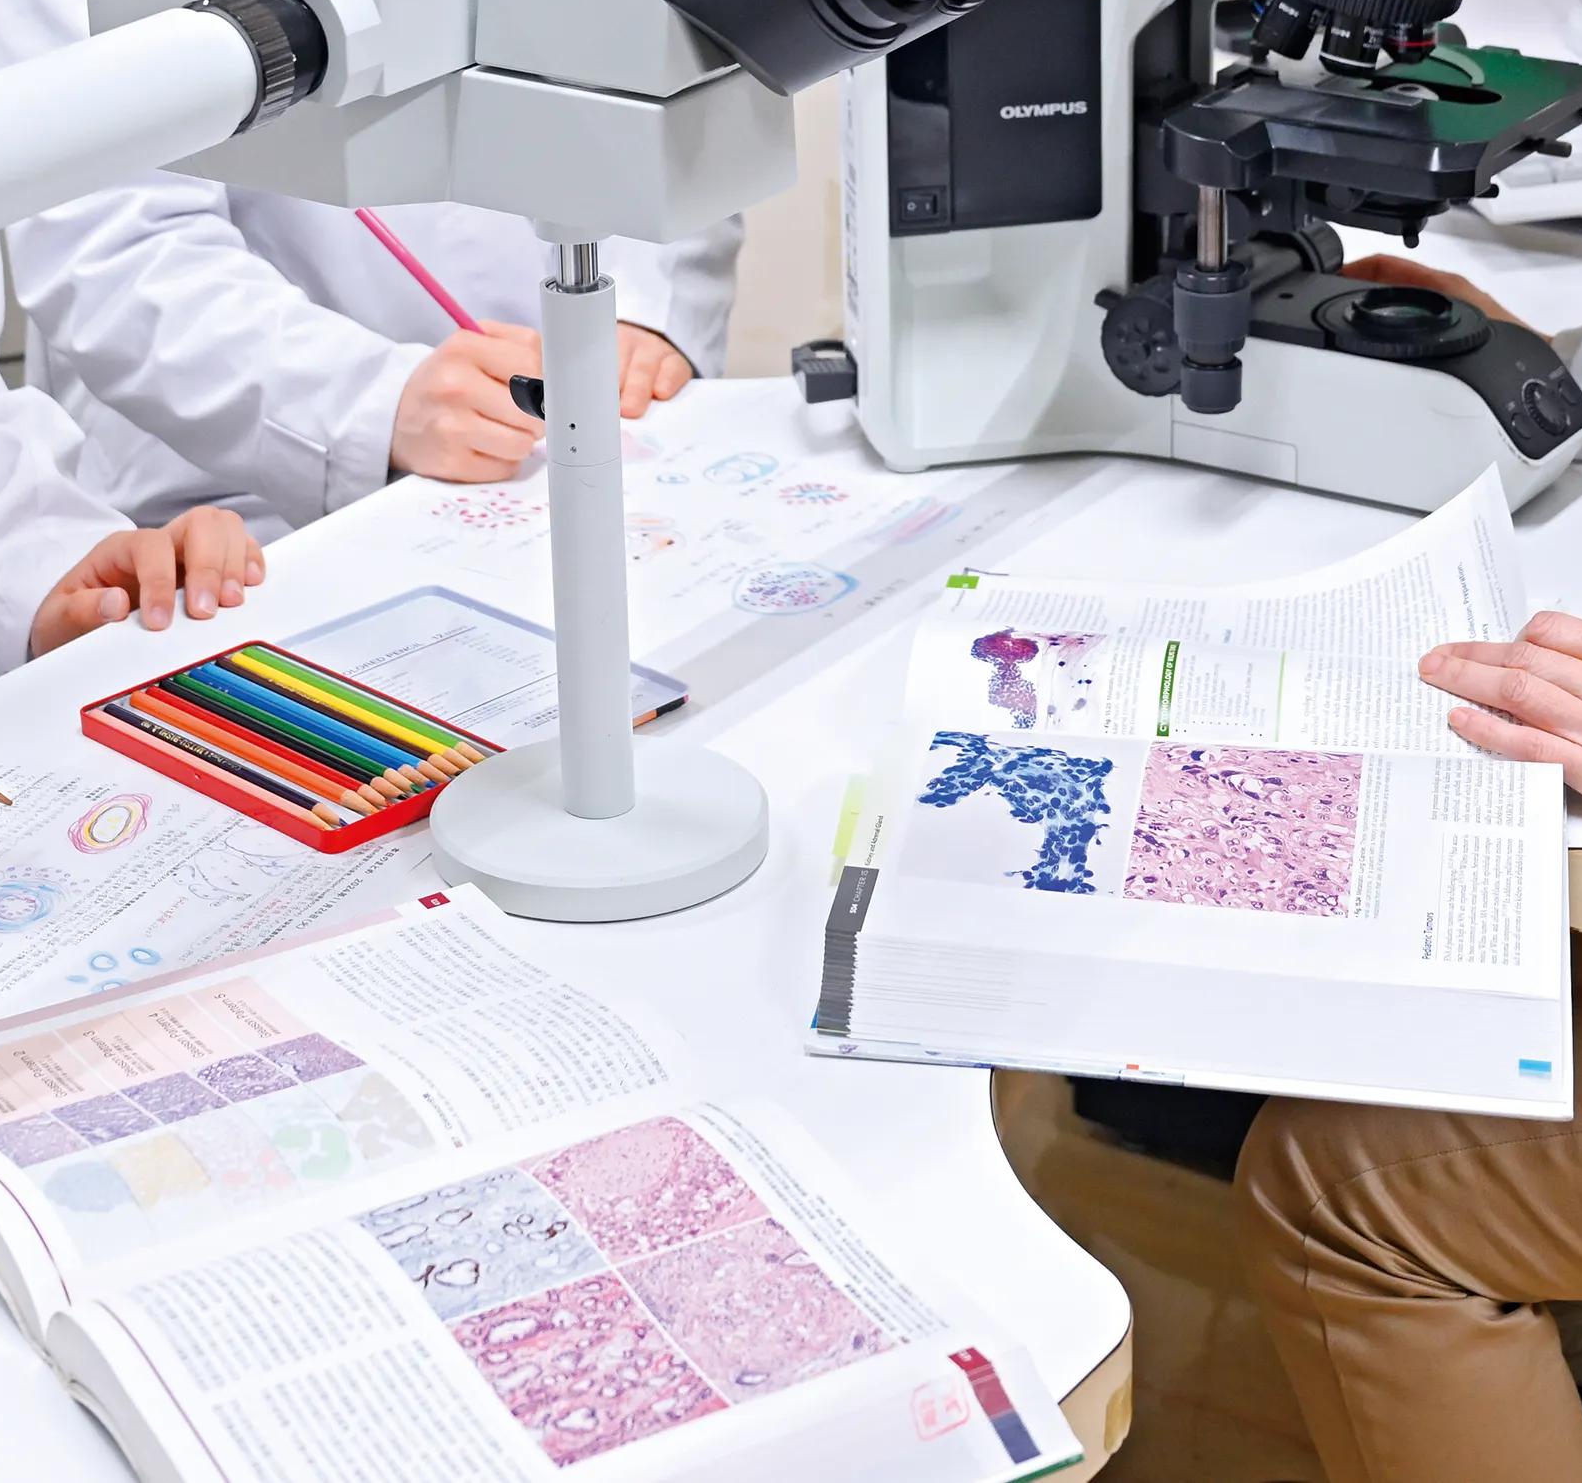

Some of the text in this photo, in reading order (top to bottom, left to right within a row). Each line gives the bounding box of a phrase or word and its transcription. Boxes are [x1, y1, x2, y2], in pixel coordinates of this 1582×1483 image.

[1000, 101, 1087, 119] OLYMPUS
[1456, 562, 1476, 638] Collection, Preparation,
[1481, 623, 1489, 641] uracy
[342, 656, 385, 677] OLORED
[385, 639, 425, 659] PENCIL
[431, 633, 443, 641] 12
[1159, 668, 1172, 732] CYTOMORPHOLOGY
[1103, 717, 1111, 728] Fig.
[158, 727, 206, 755] MITSU-BISHI
[874, 814, 884, 828] Gland
[870, 827, 880, 844] Adrenal
[362, 844, 400, 876] 本日のまとめ
[864, 851, 875, 866] Kidney
[852, 876, 867, 902] CHAPTER
[849, 902, 858, 914] 504
[1421, 911, 1434, 960] Pediatric Tumors
[213, 989, 226, 1002] 5
[148, 1009, 159, 1021] 4
[220, 996, 247, 1022] Pattern
[82, 1026, 95, 1040] 3
[152, 1013, 181, 1041] Pattern
[12, 1046, 24, 1059] 2
[87, 1031, 117, 1061] Pattern
[17, 1052, 46, 1081] Pattern
